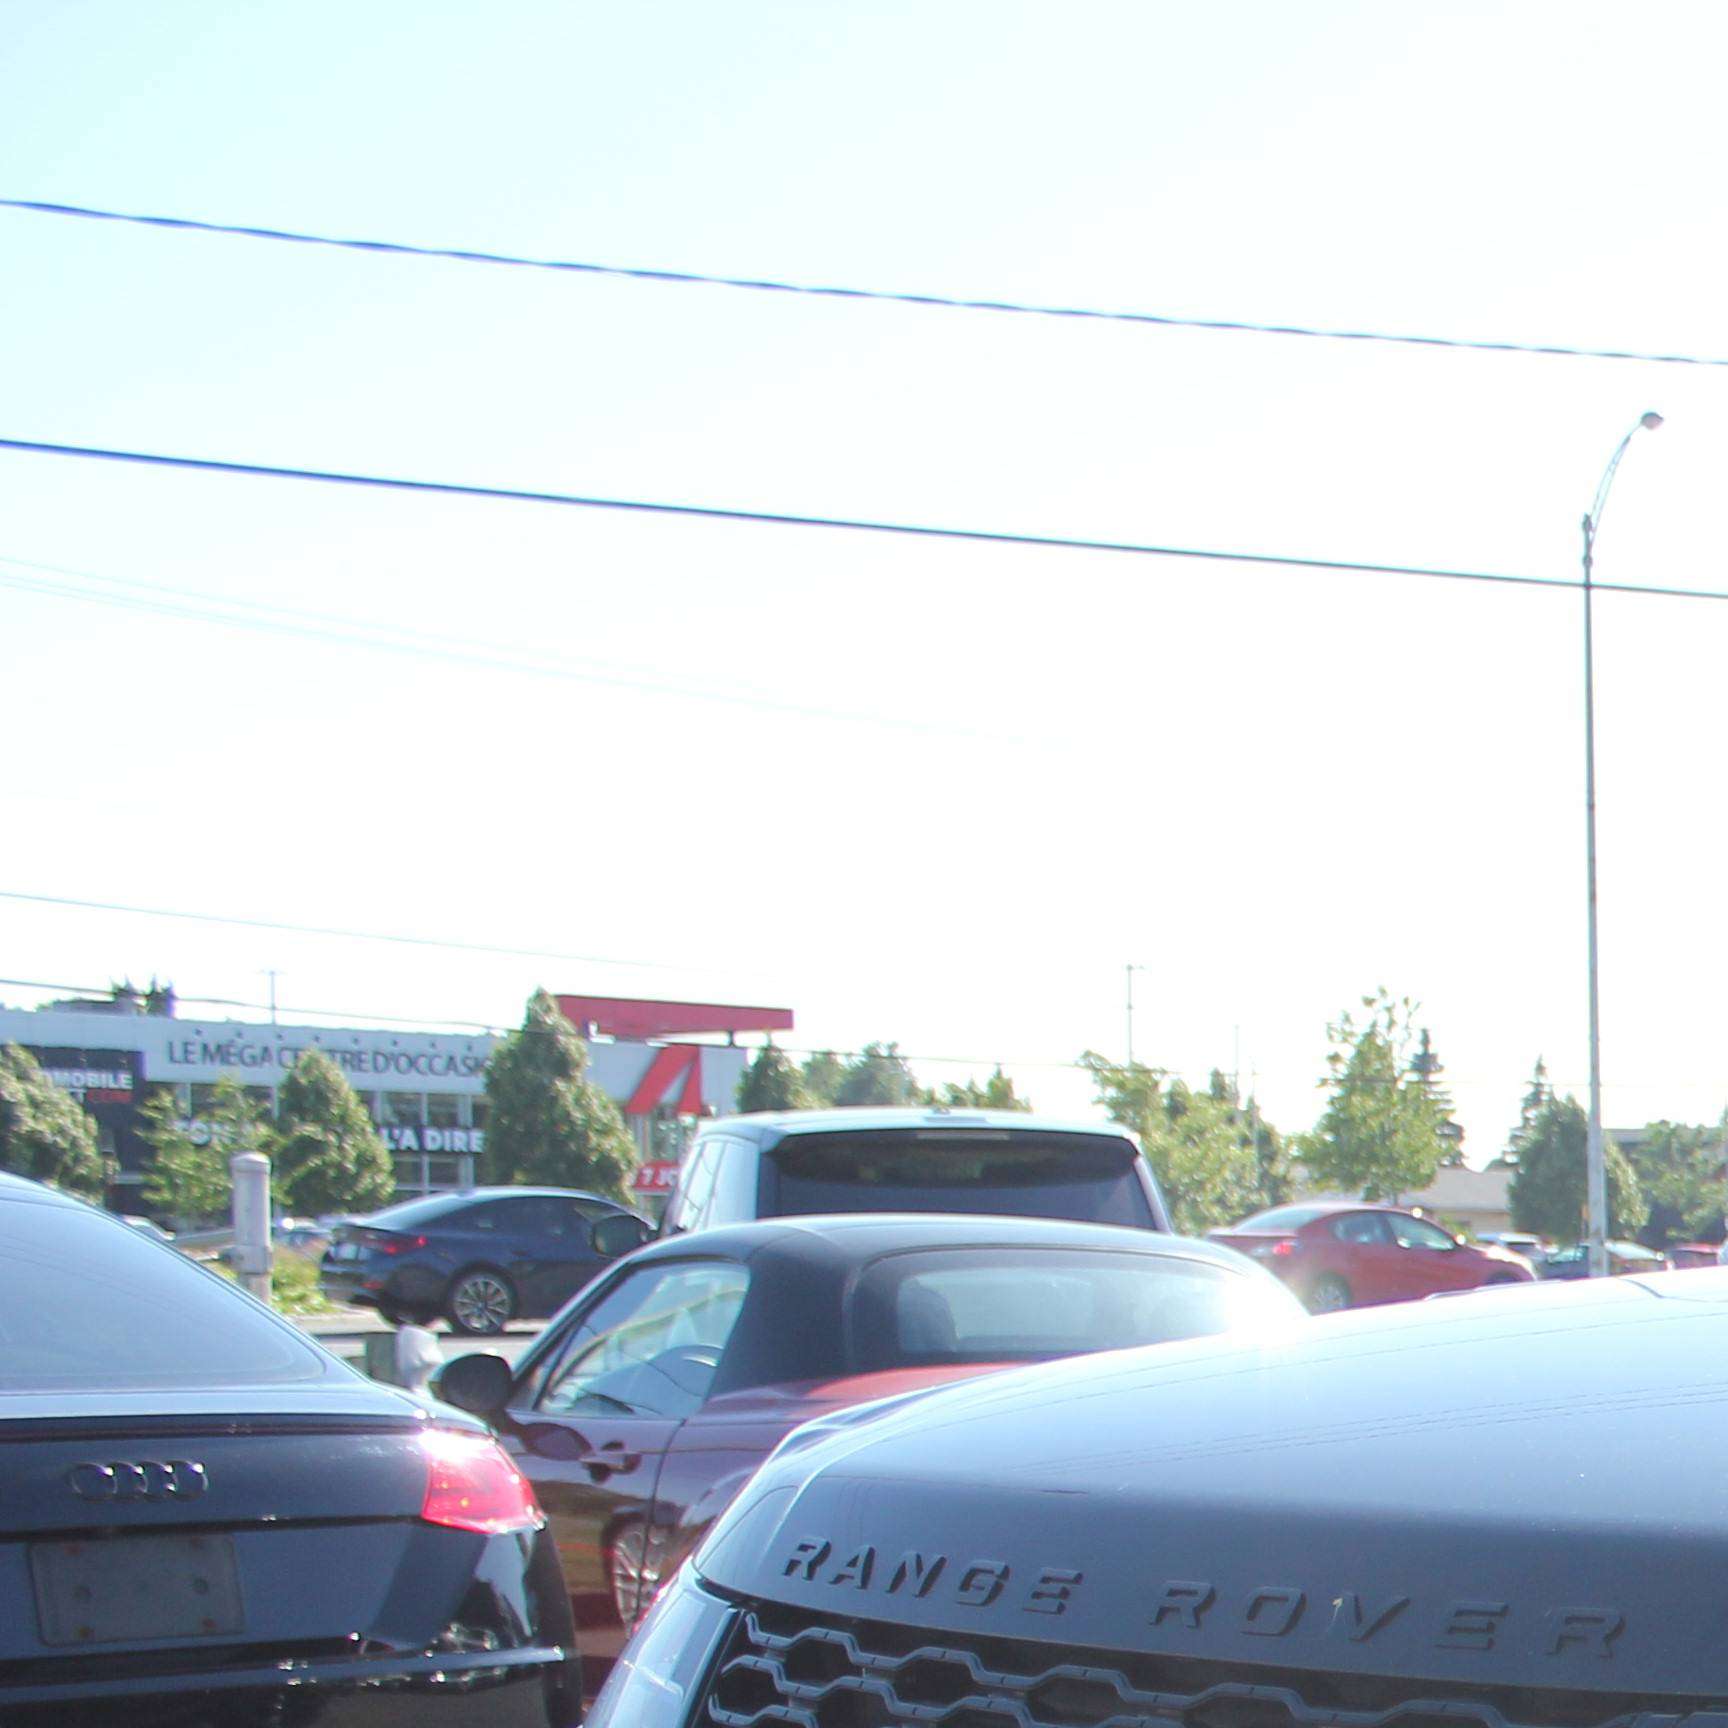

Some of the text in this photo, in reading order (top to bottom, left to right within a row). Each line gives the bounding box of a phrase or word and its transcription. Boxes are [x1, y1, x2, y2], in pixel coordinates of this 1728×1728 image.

[168, 1041, 197, 1064] LE
[201, 1038, 273, 1067] MÉGA
[278, 1047, 369, 1073] CETRE
[44, 1070, 133, 1089] MOBILE
[782, 1536, 1627, 1660] RANGE ROVER
